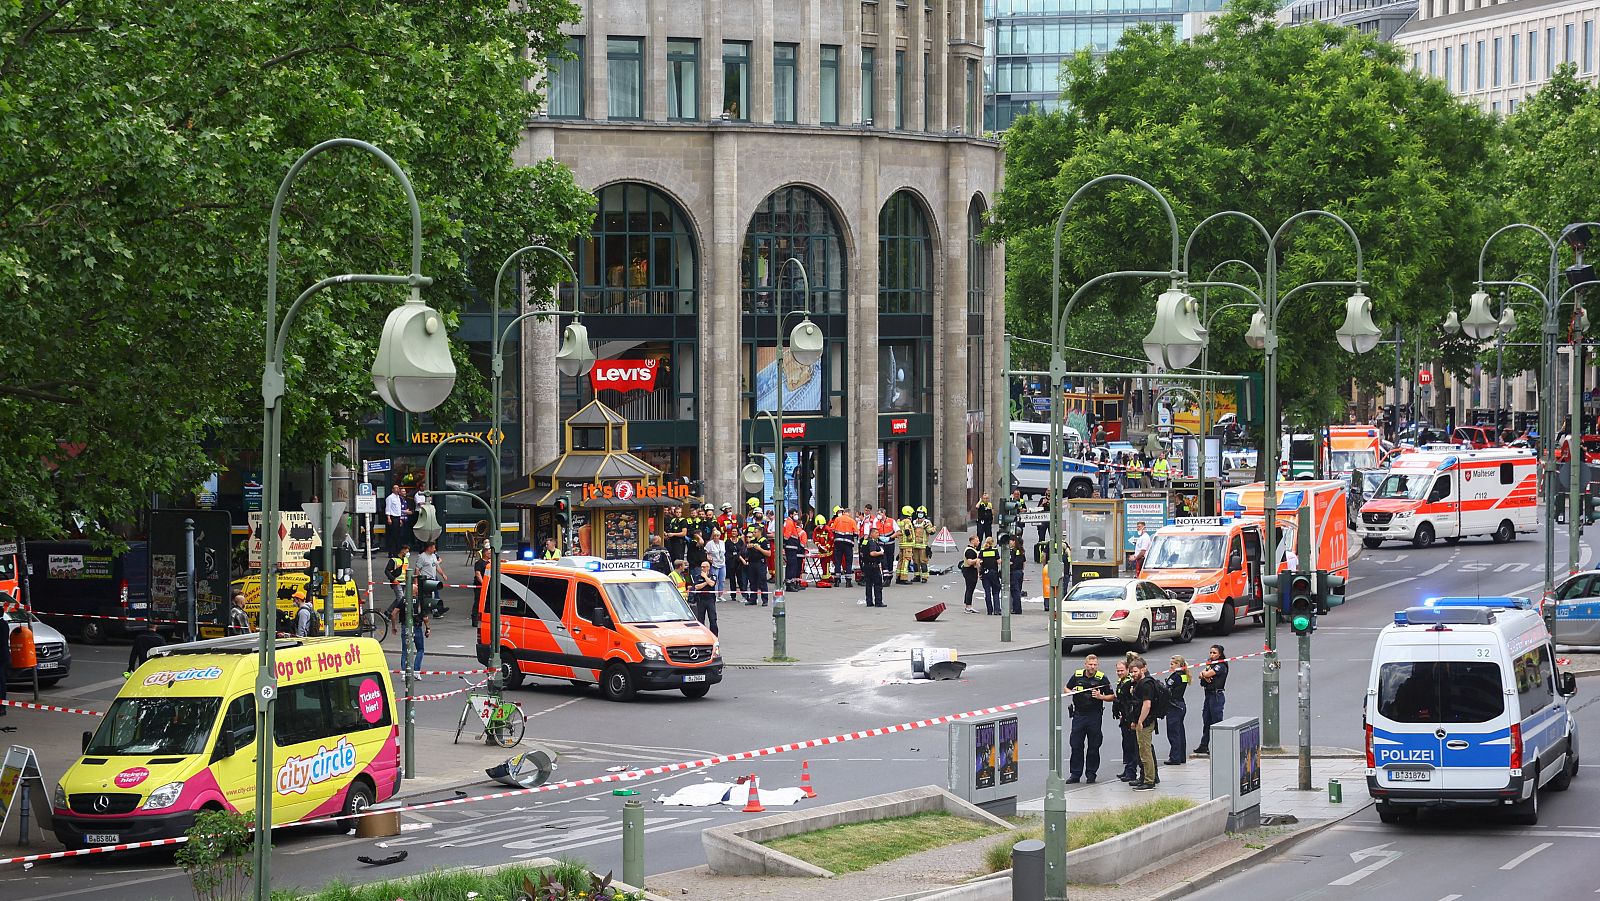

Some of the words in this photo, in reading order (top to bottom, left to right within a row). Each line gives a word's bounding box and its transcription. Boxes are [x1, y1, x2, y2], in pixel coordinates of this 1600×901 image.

[1473, 469, 1496, 478] Malteser
[636, 481, 689, 499] berlin
[1329, 533, 1345, 569] 112
[602, 562, 641, 570] NOTARZT
[296, 656, 312, 674] on
[318, 652, 343, 672] Hop
[345, 643, 362, 666] off
[1477, 648, 1490, 658] 32
[359, 690, 381, 703] Tickets
[1381, 749, 1435, 761] POLIZEI
